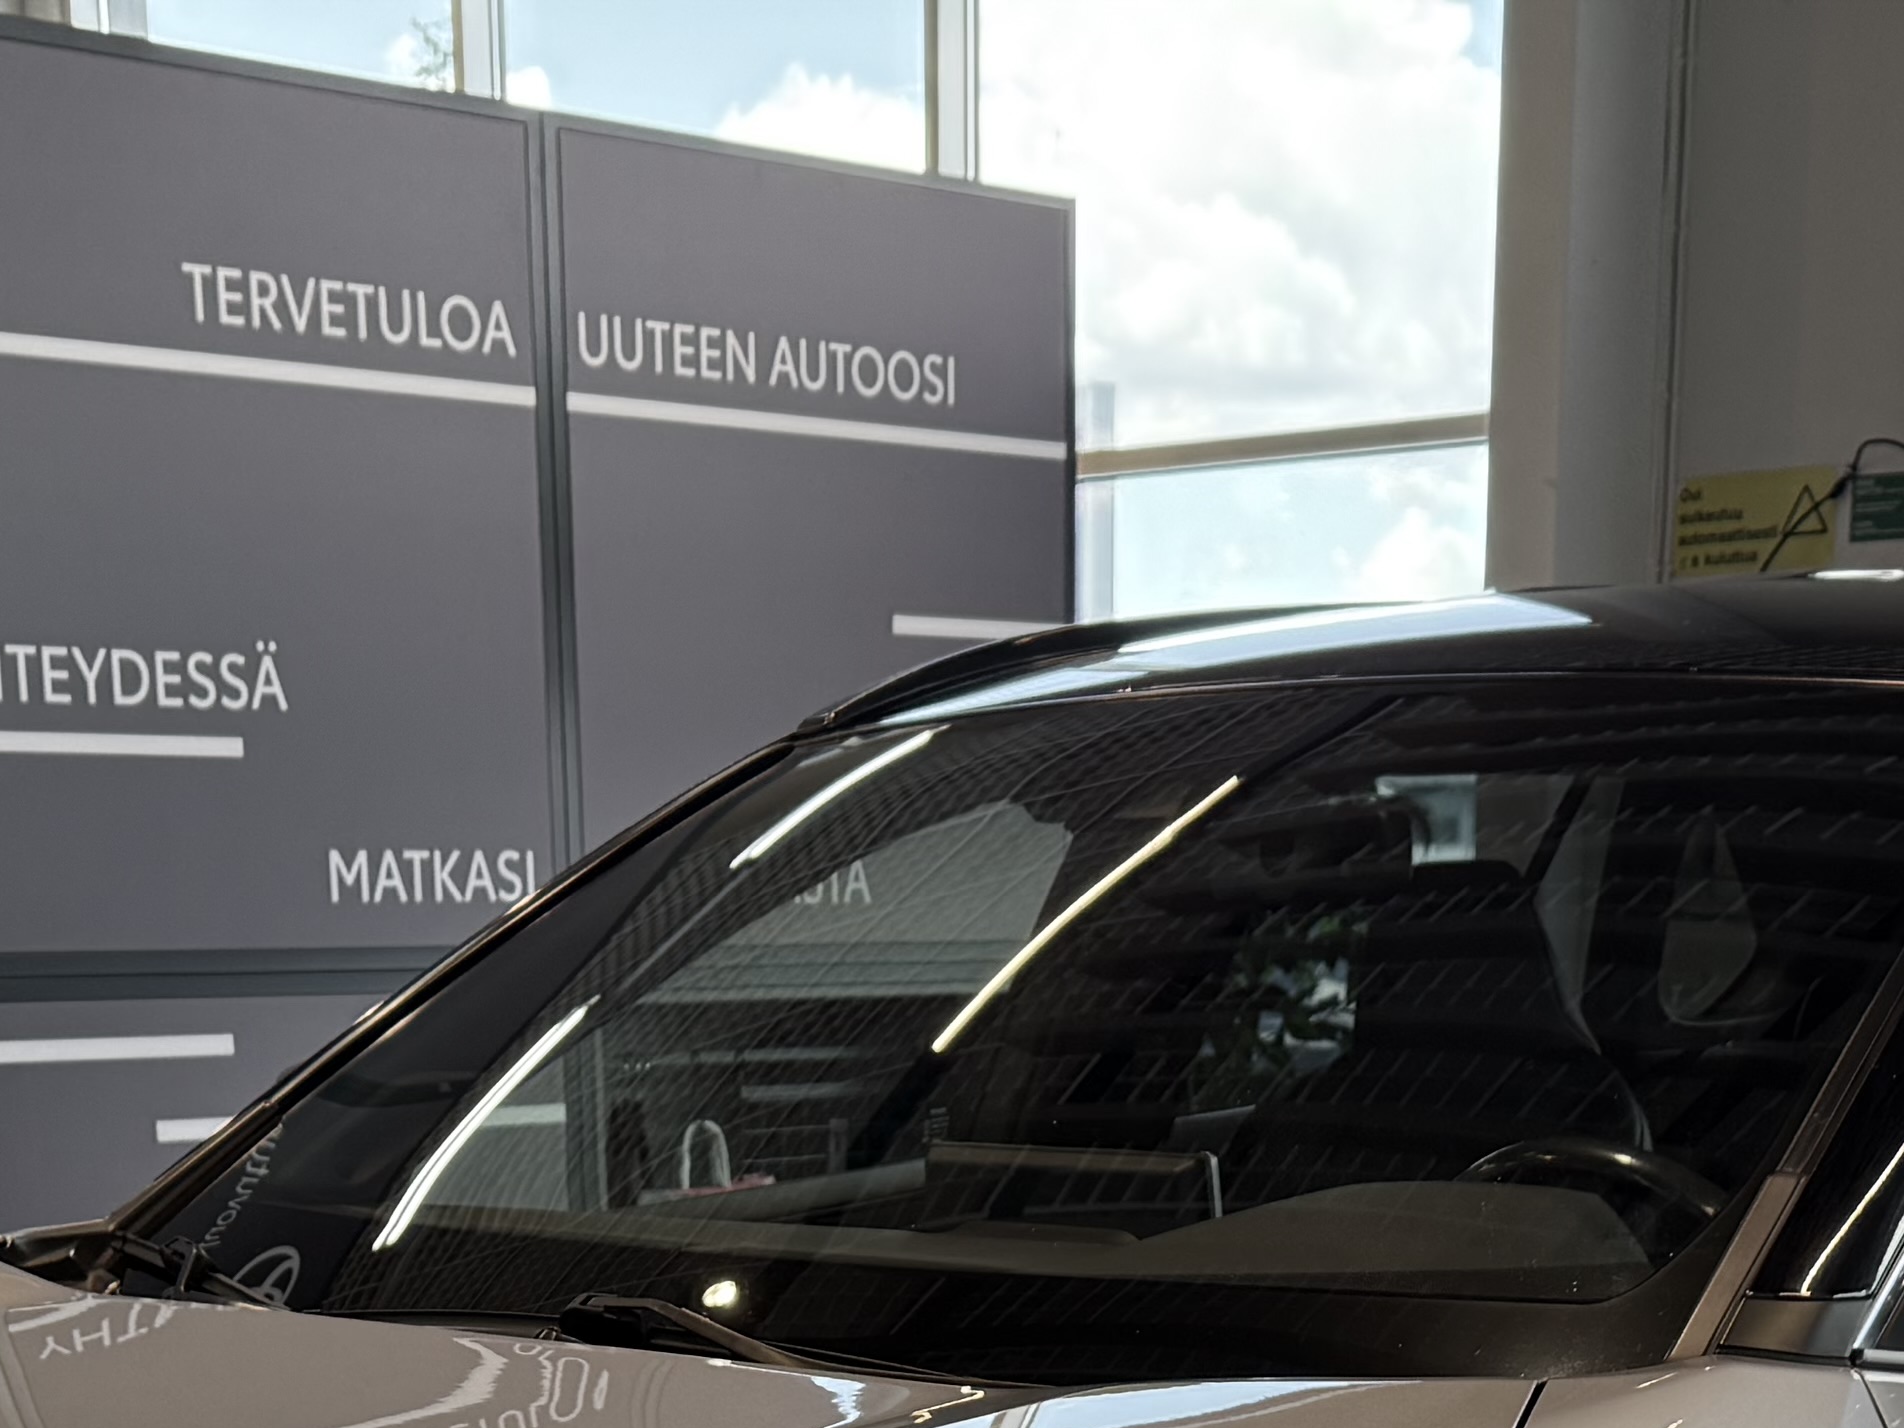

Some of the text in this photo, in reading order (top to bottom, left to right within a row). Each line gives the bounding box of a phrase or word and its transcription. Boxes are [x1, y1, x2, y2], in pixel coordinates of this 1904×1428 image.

[182, 262, 955, 407] TERVETULOA UUTEEN AUTOOSI
[328, 849, 537, 903] MATKASI
